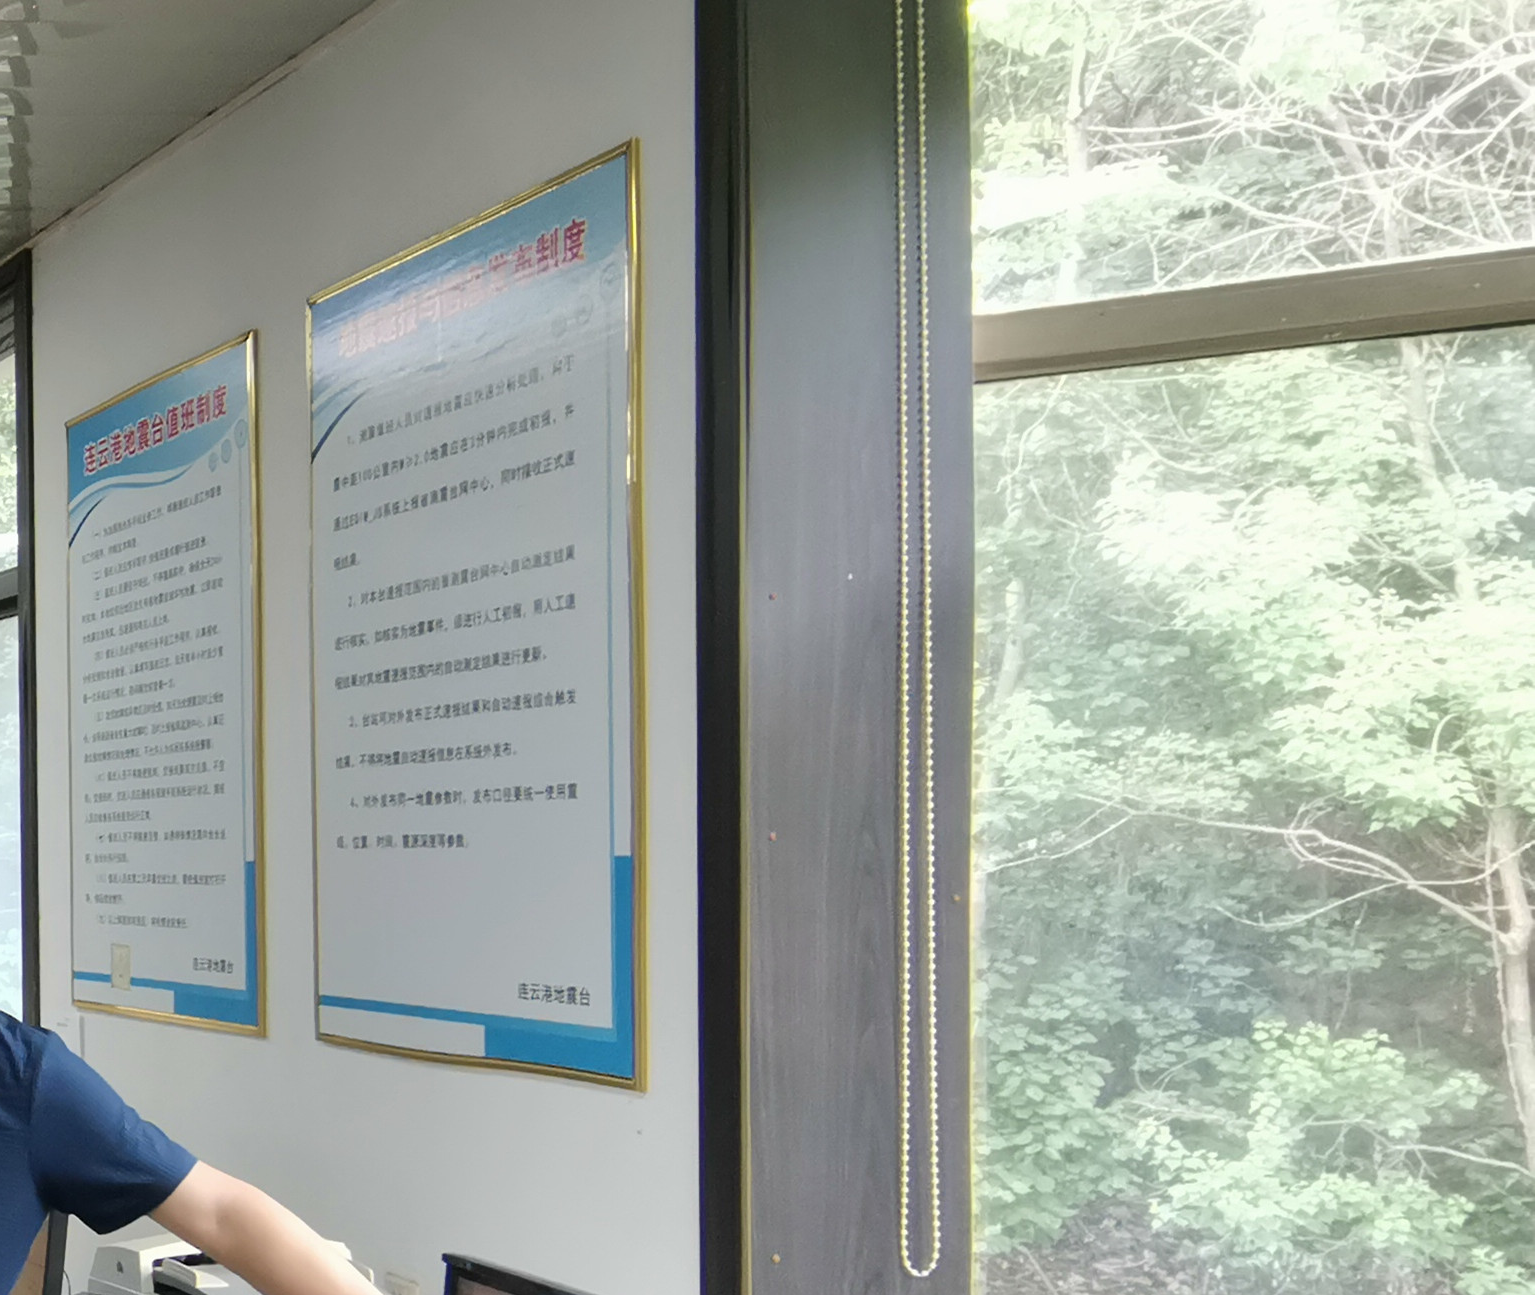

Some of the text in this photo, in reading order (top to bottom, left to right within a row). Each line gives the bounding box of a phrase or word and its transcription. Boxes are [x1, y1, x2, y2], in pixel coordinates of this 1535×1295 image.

[84, 384, 227, 474] 连云港地震台值班制度
[517, 982, 591, 1007] 连云港地震台
